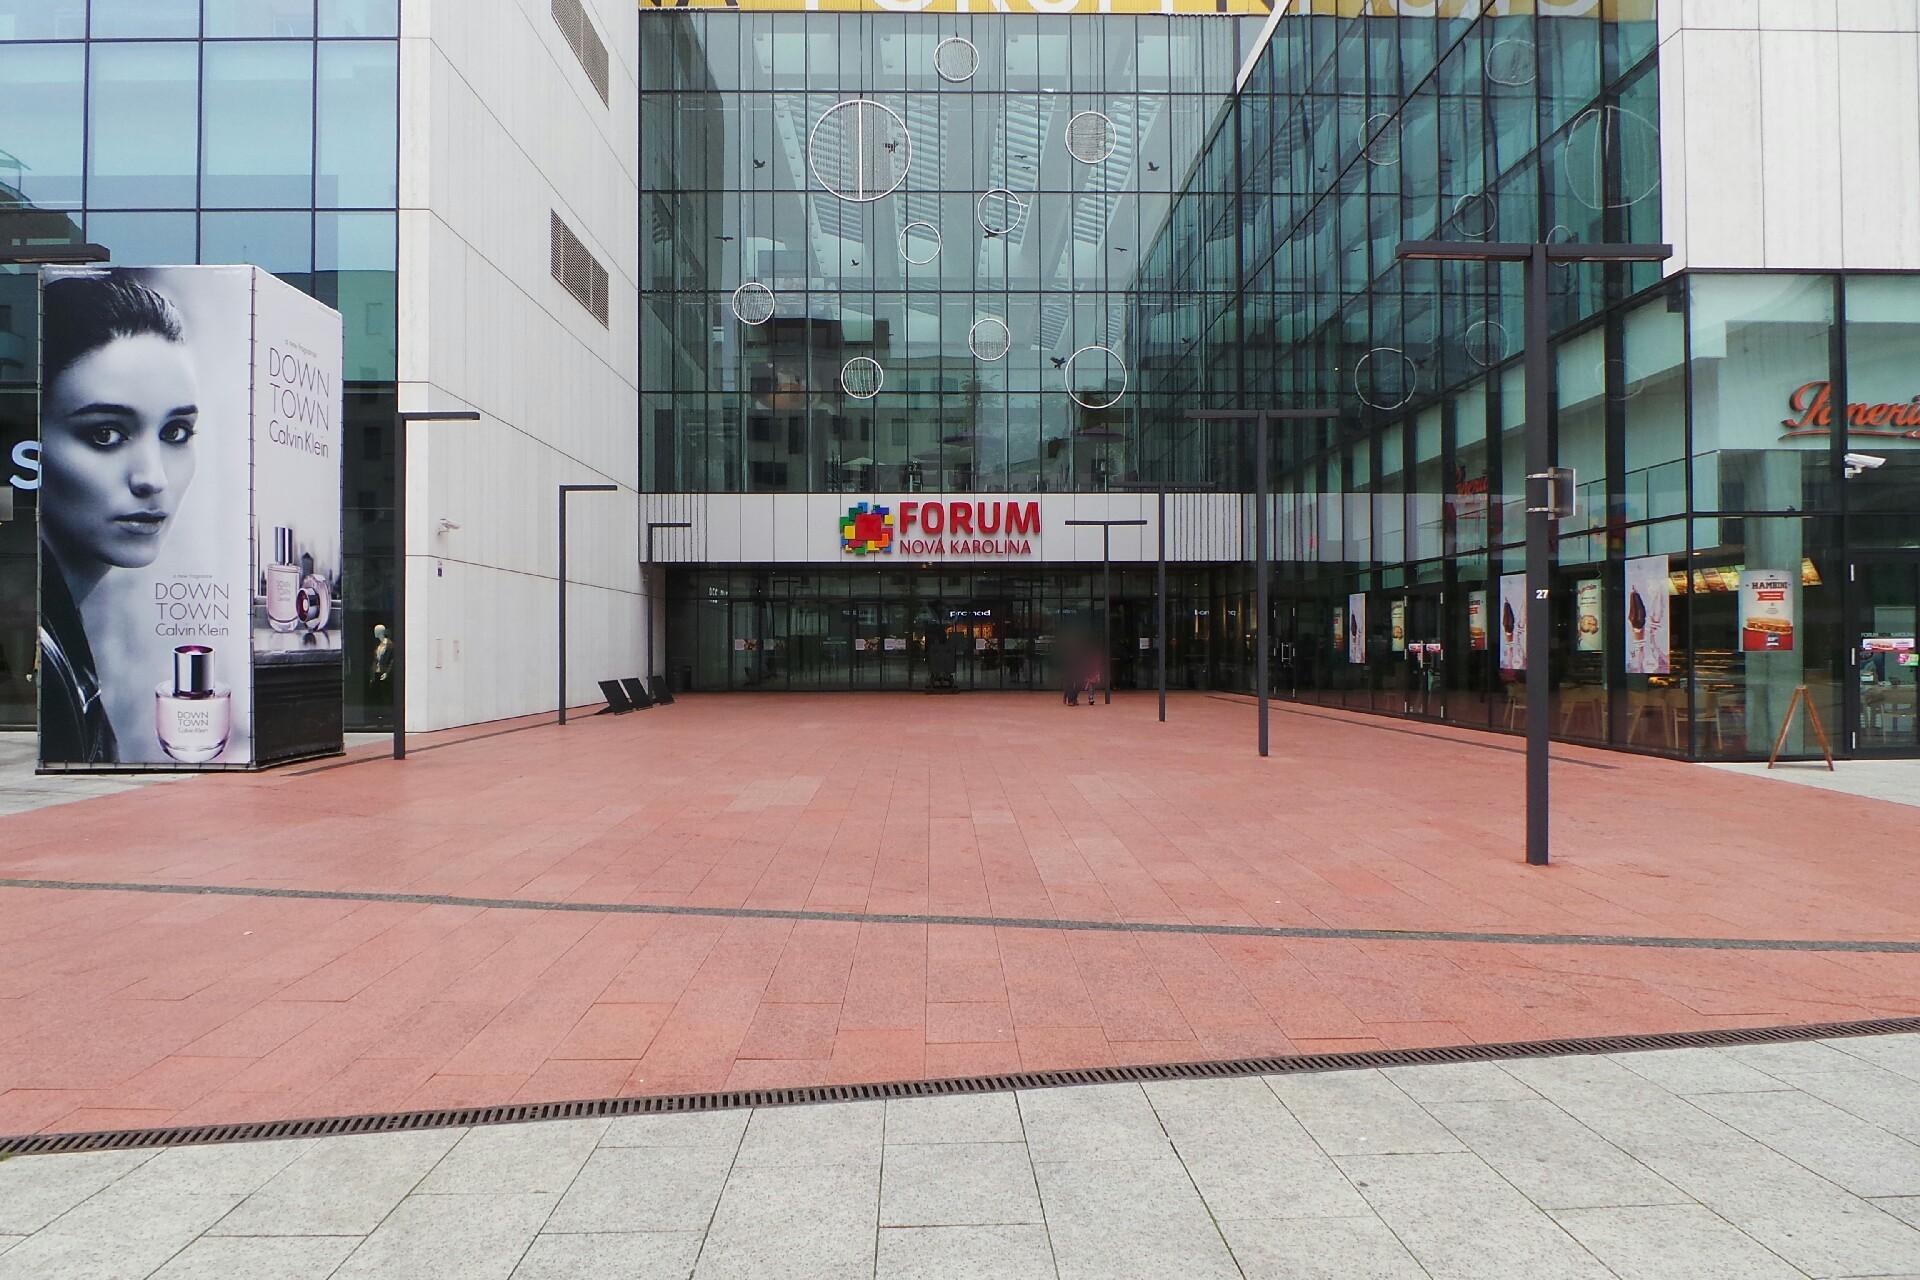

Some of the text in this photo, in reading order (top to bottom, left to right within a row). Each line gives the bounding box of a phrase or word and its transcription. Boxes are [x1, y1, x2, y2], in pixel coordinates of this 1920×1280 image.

[269, 347, 330, 398] DOWN
[269, 382, 330, 431] TOWN
[269, 419, 329, 458] Calvin Klein
[899, 501, 1041, 536] FORUM
[950, 539, 1032, 554] KAROLINA
[155, 582, 229, 600] DOWN
[1535, 589, 1549, 599] 27
[154, 602, 229, 620] TOWN
[155, 622, 229, 637] Calvin Klein
[177, 711, 209, 719] DOWN
